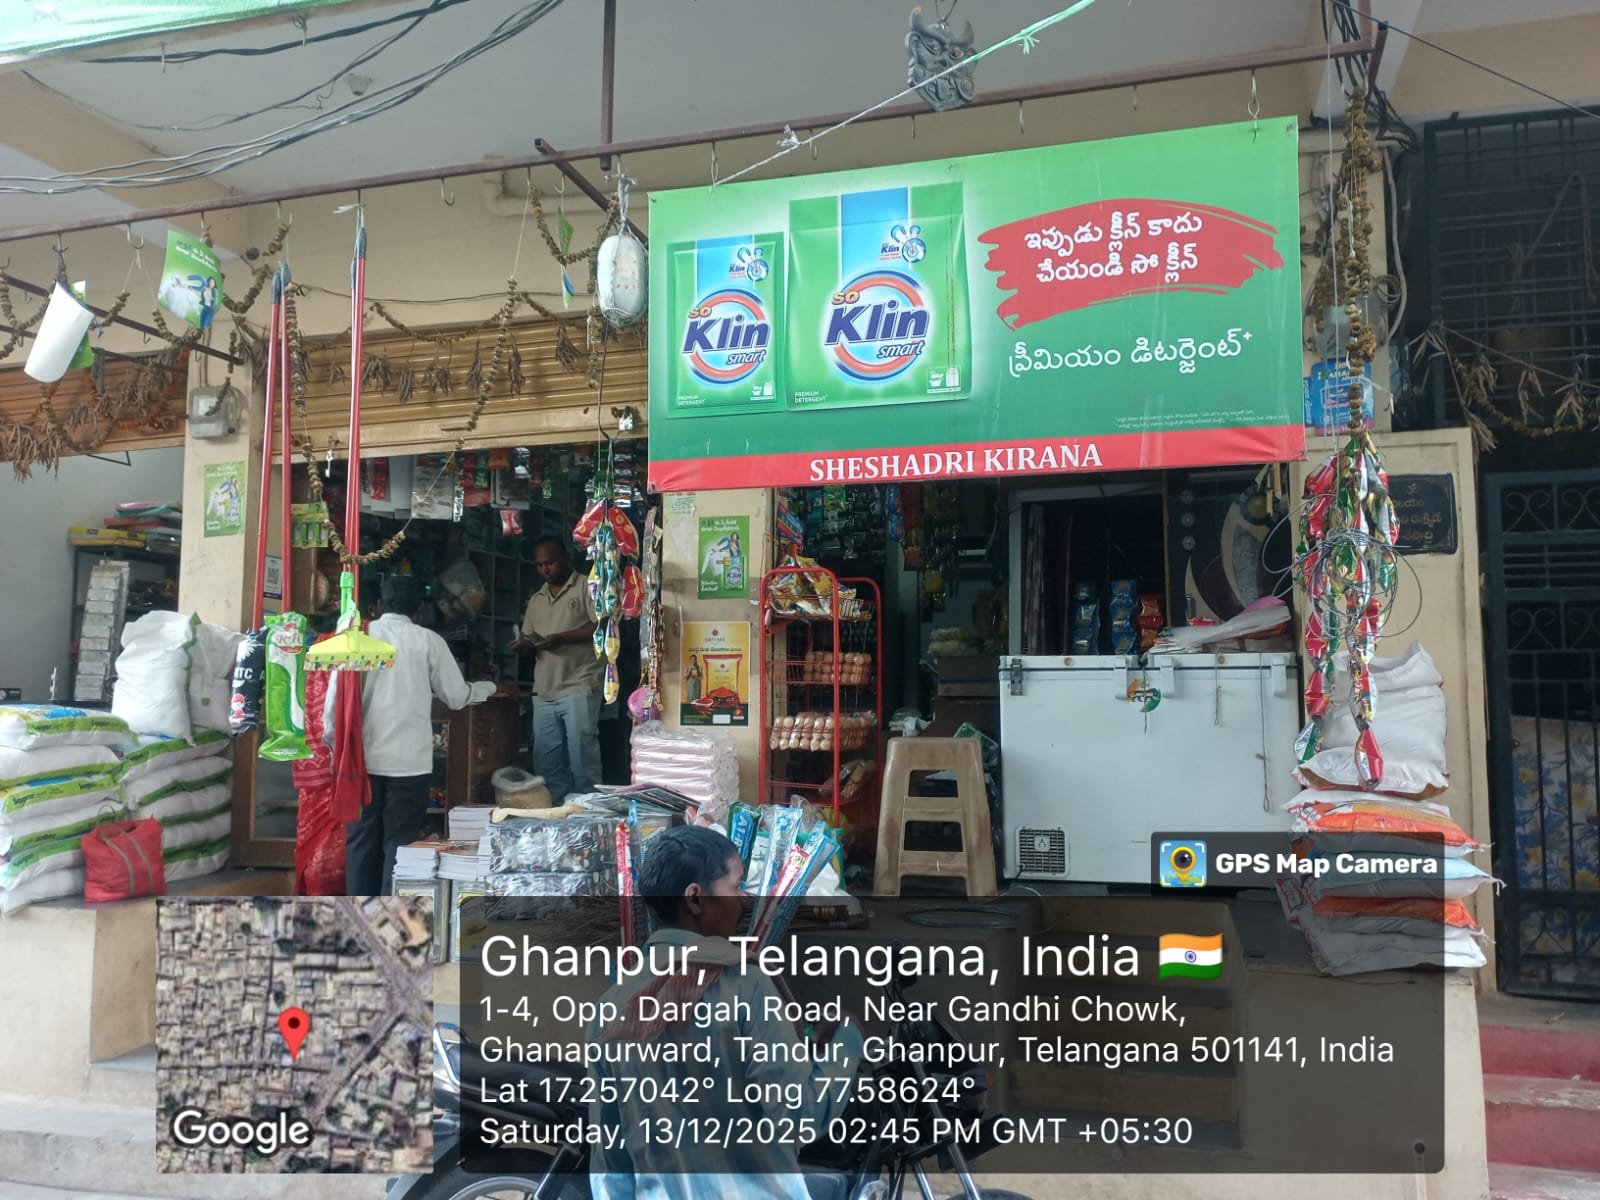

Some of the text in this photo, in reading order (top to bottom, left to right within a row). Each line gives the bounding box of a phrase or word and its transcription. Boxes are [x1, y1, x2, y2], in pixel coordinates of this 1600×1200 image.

[1024, 211, 1202, 257] ఇప్పుడు క్లీన్ కాదు
[1035, 242, 1198, 283] చేయండి సో క్లీన్
[682, 314, 771, 353] Klin
[825, 299, 930, 345] Klin
[726, 349, 767, 366] smart
[877, 340, 925, 359] smart
[1008, 341, 1121, 377] ప్రీమియం
[810, 443, 1103, 481] SHESHADRI KIRANA
